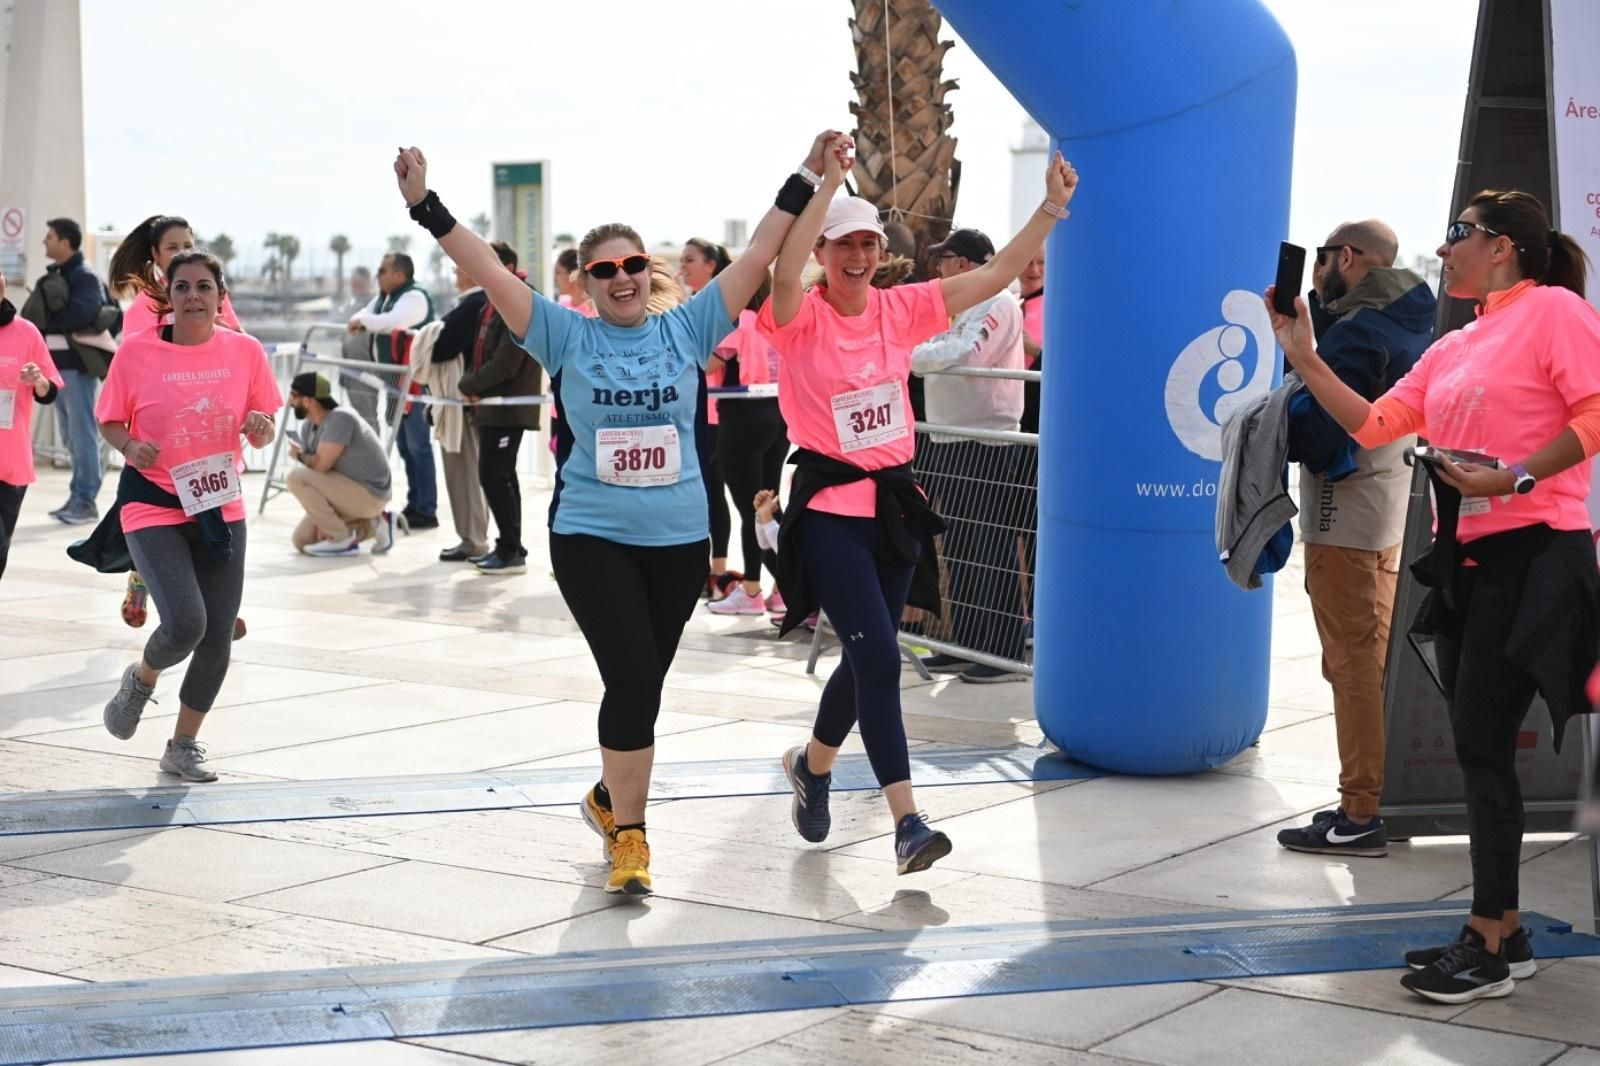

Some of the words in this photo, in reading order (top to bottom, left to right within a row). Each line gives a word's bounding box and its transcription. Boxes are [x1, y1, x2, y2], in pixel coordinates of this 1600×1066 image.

[1565, 97, 1600, 118] Áre
[592, 382, 679, 412] nerja
[605, 411, 670, 423] ATLETISMO
[850, 403, 892, 433] 3247
[613, 446, 666, 471] 3870
[189, 470, 228, 498] 3466
[1136, 478, 1216, 497] www.do
